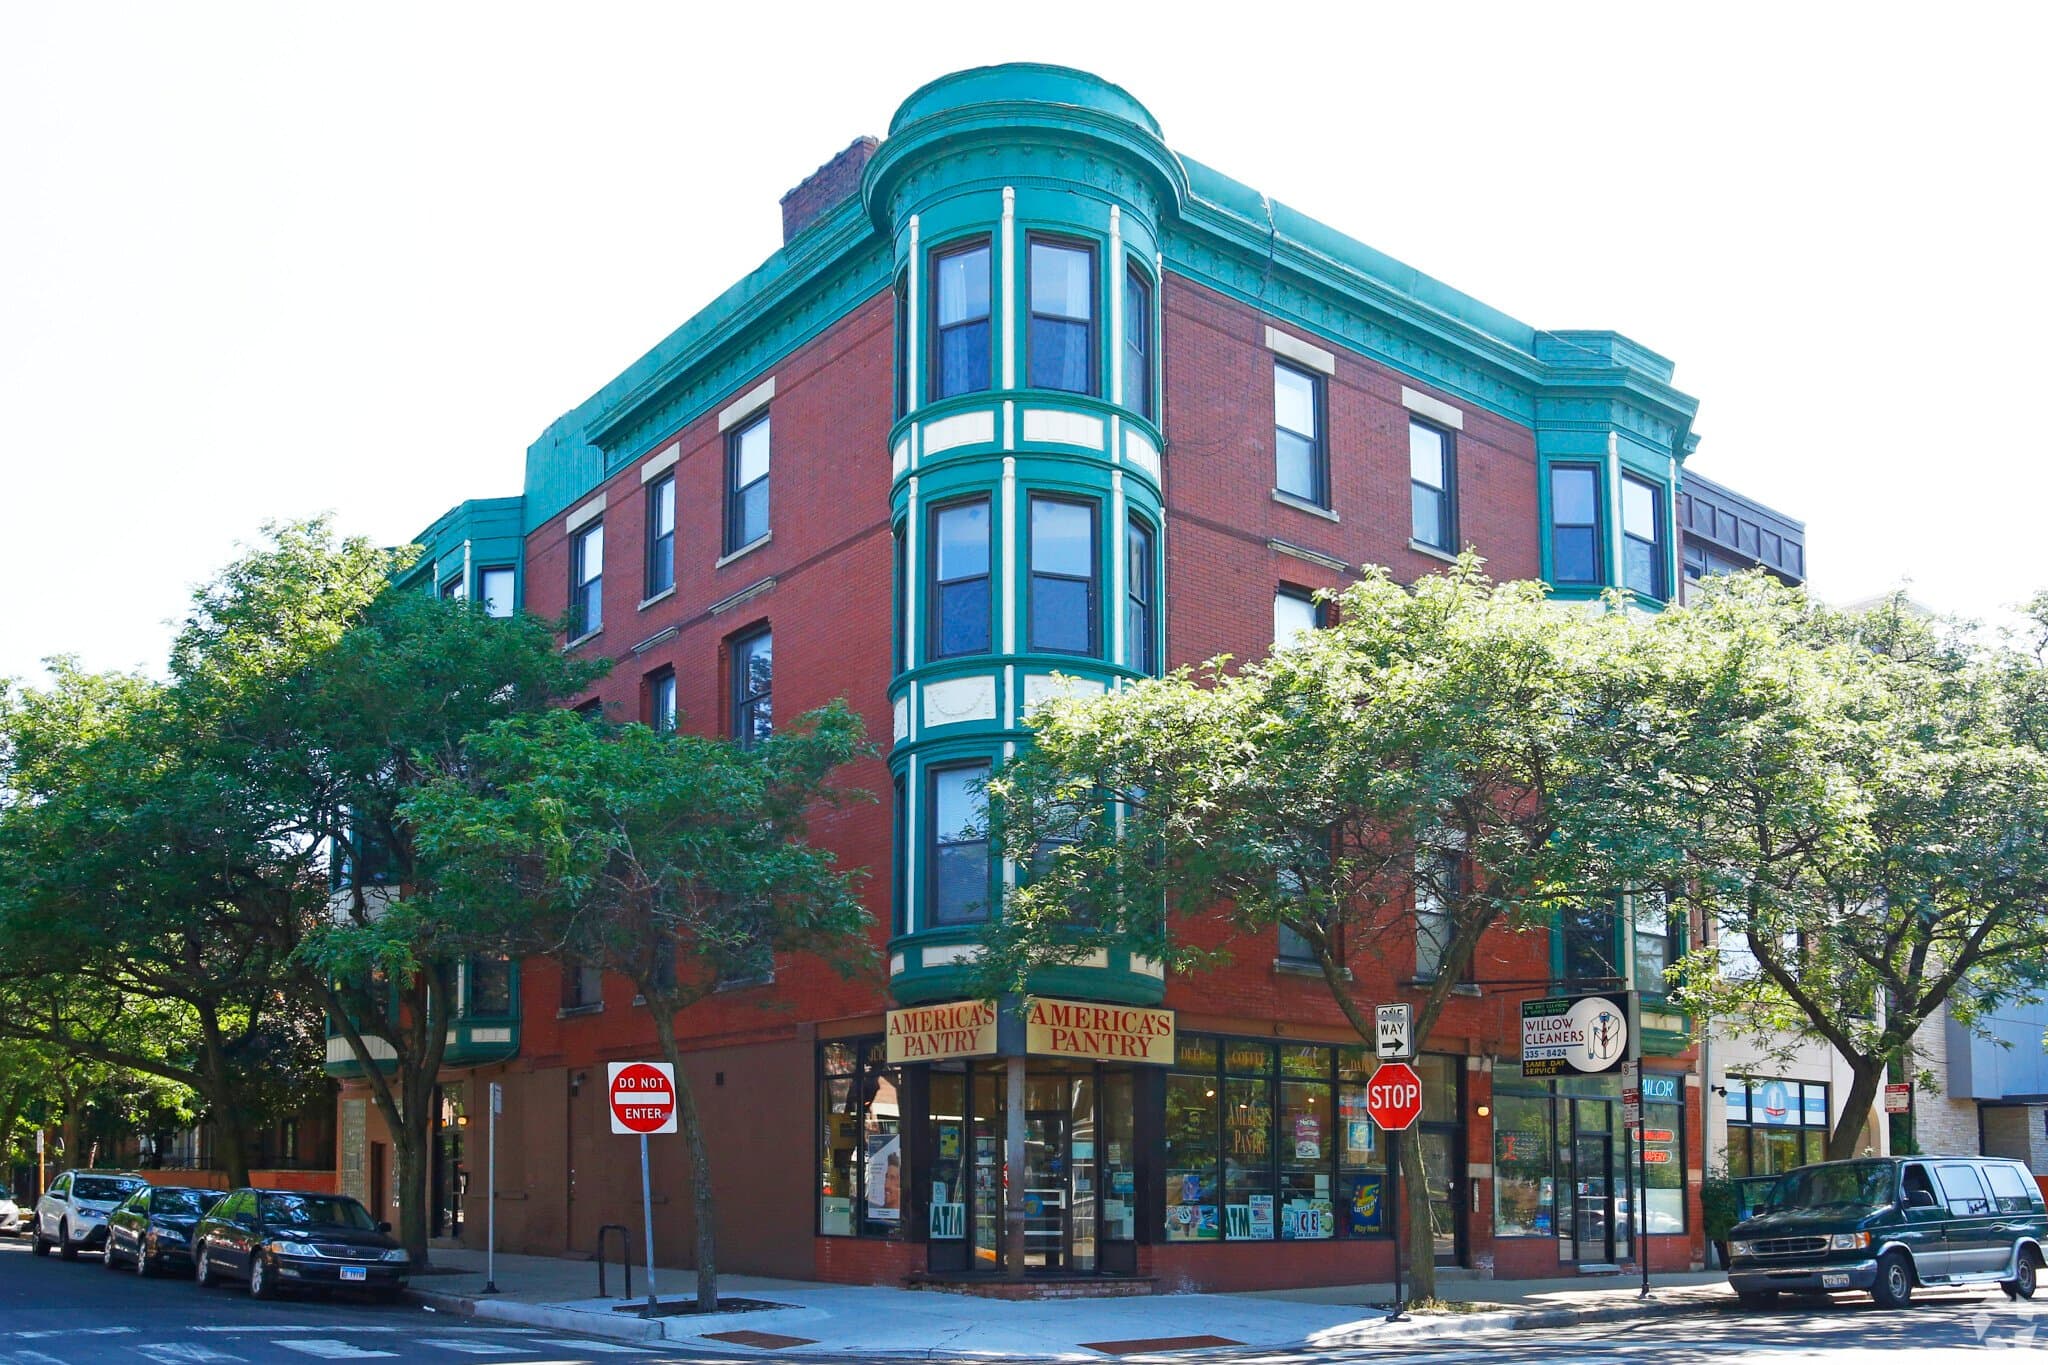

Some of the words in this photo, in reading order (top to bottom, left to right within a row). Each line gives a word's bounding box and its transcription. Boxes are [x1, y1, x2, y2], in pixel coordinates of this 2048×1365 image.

[889, 1002, 995, 1036] AMERICA'S
[1028, 1002, 1171, 1037] AMERICA'S
[1380, 1023, 1404, 1035] WAY
[1525, 1018, 1574, 1031] WILLOW
[903, 1028, 980, 1057] PANTRY
[1050, 1028, 1153, 1058] PANTRY
[1525, 1030, 1585, 1045] CLEANERS
[1525, 1061, 1546, 1069] SAME
[1525, 1067, 1557, 1075] SERVICE
[619, 1077, 636, 1089] DO
[641, 1077, 664, 1089] NOT
[1371, 1084, 1418, 1109] STOP
[625, 1108, 662, 1119] ENTER
[931, 1206, 962, 1237] ATM
[1225, 1207, 1249, 1237] ATM
